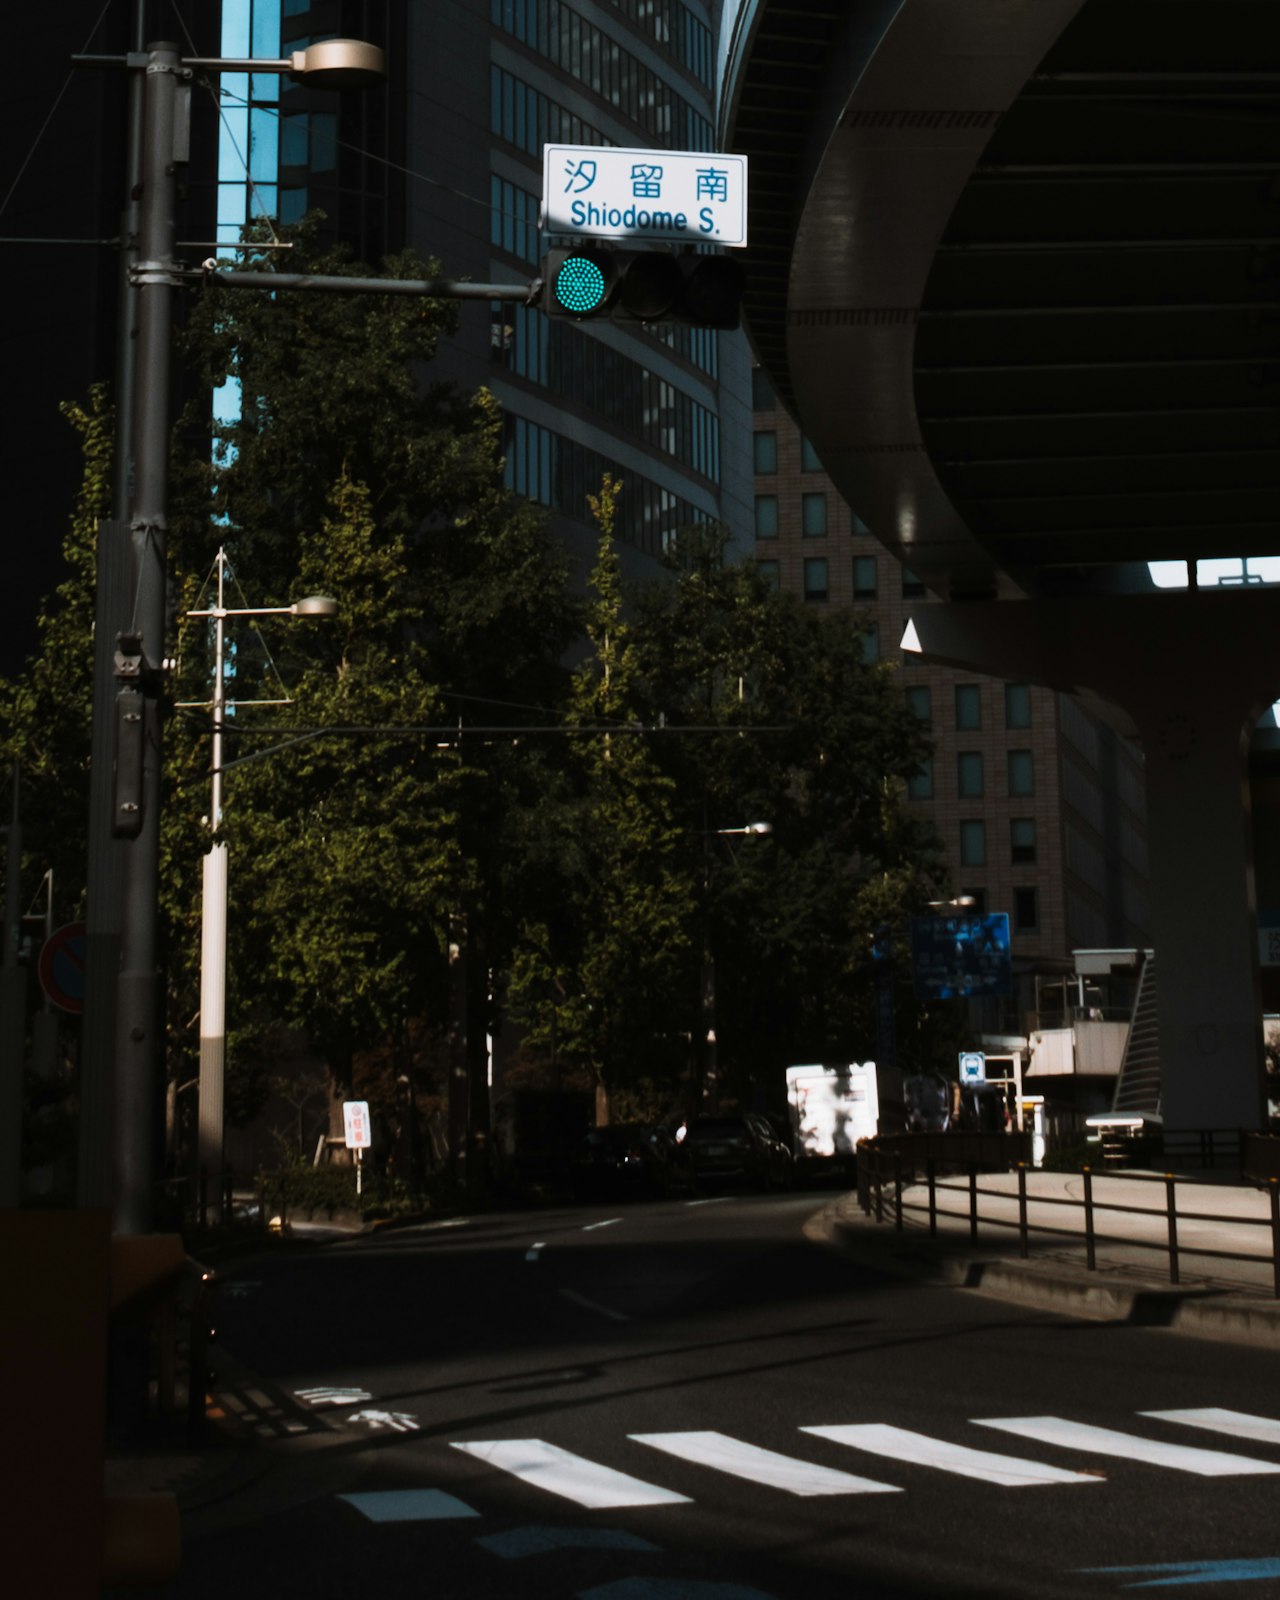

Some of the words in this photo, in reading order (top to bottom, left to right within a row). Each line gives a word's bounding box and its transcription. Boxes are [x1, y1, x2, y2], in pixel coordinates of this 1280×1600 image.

[564, 158, 729, 203] 汐留南
[571, 200, 687, 231] Shiodome
[698, 207, 720, 234] S.
